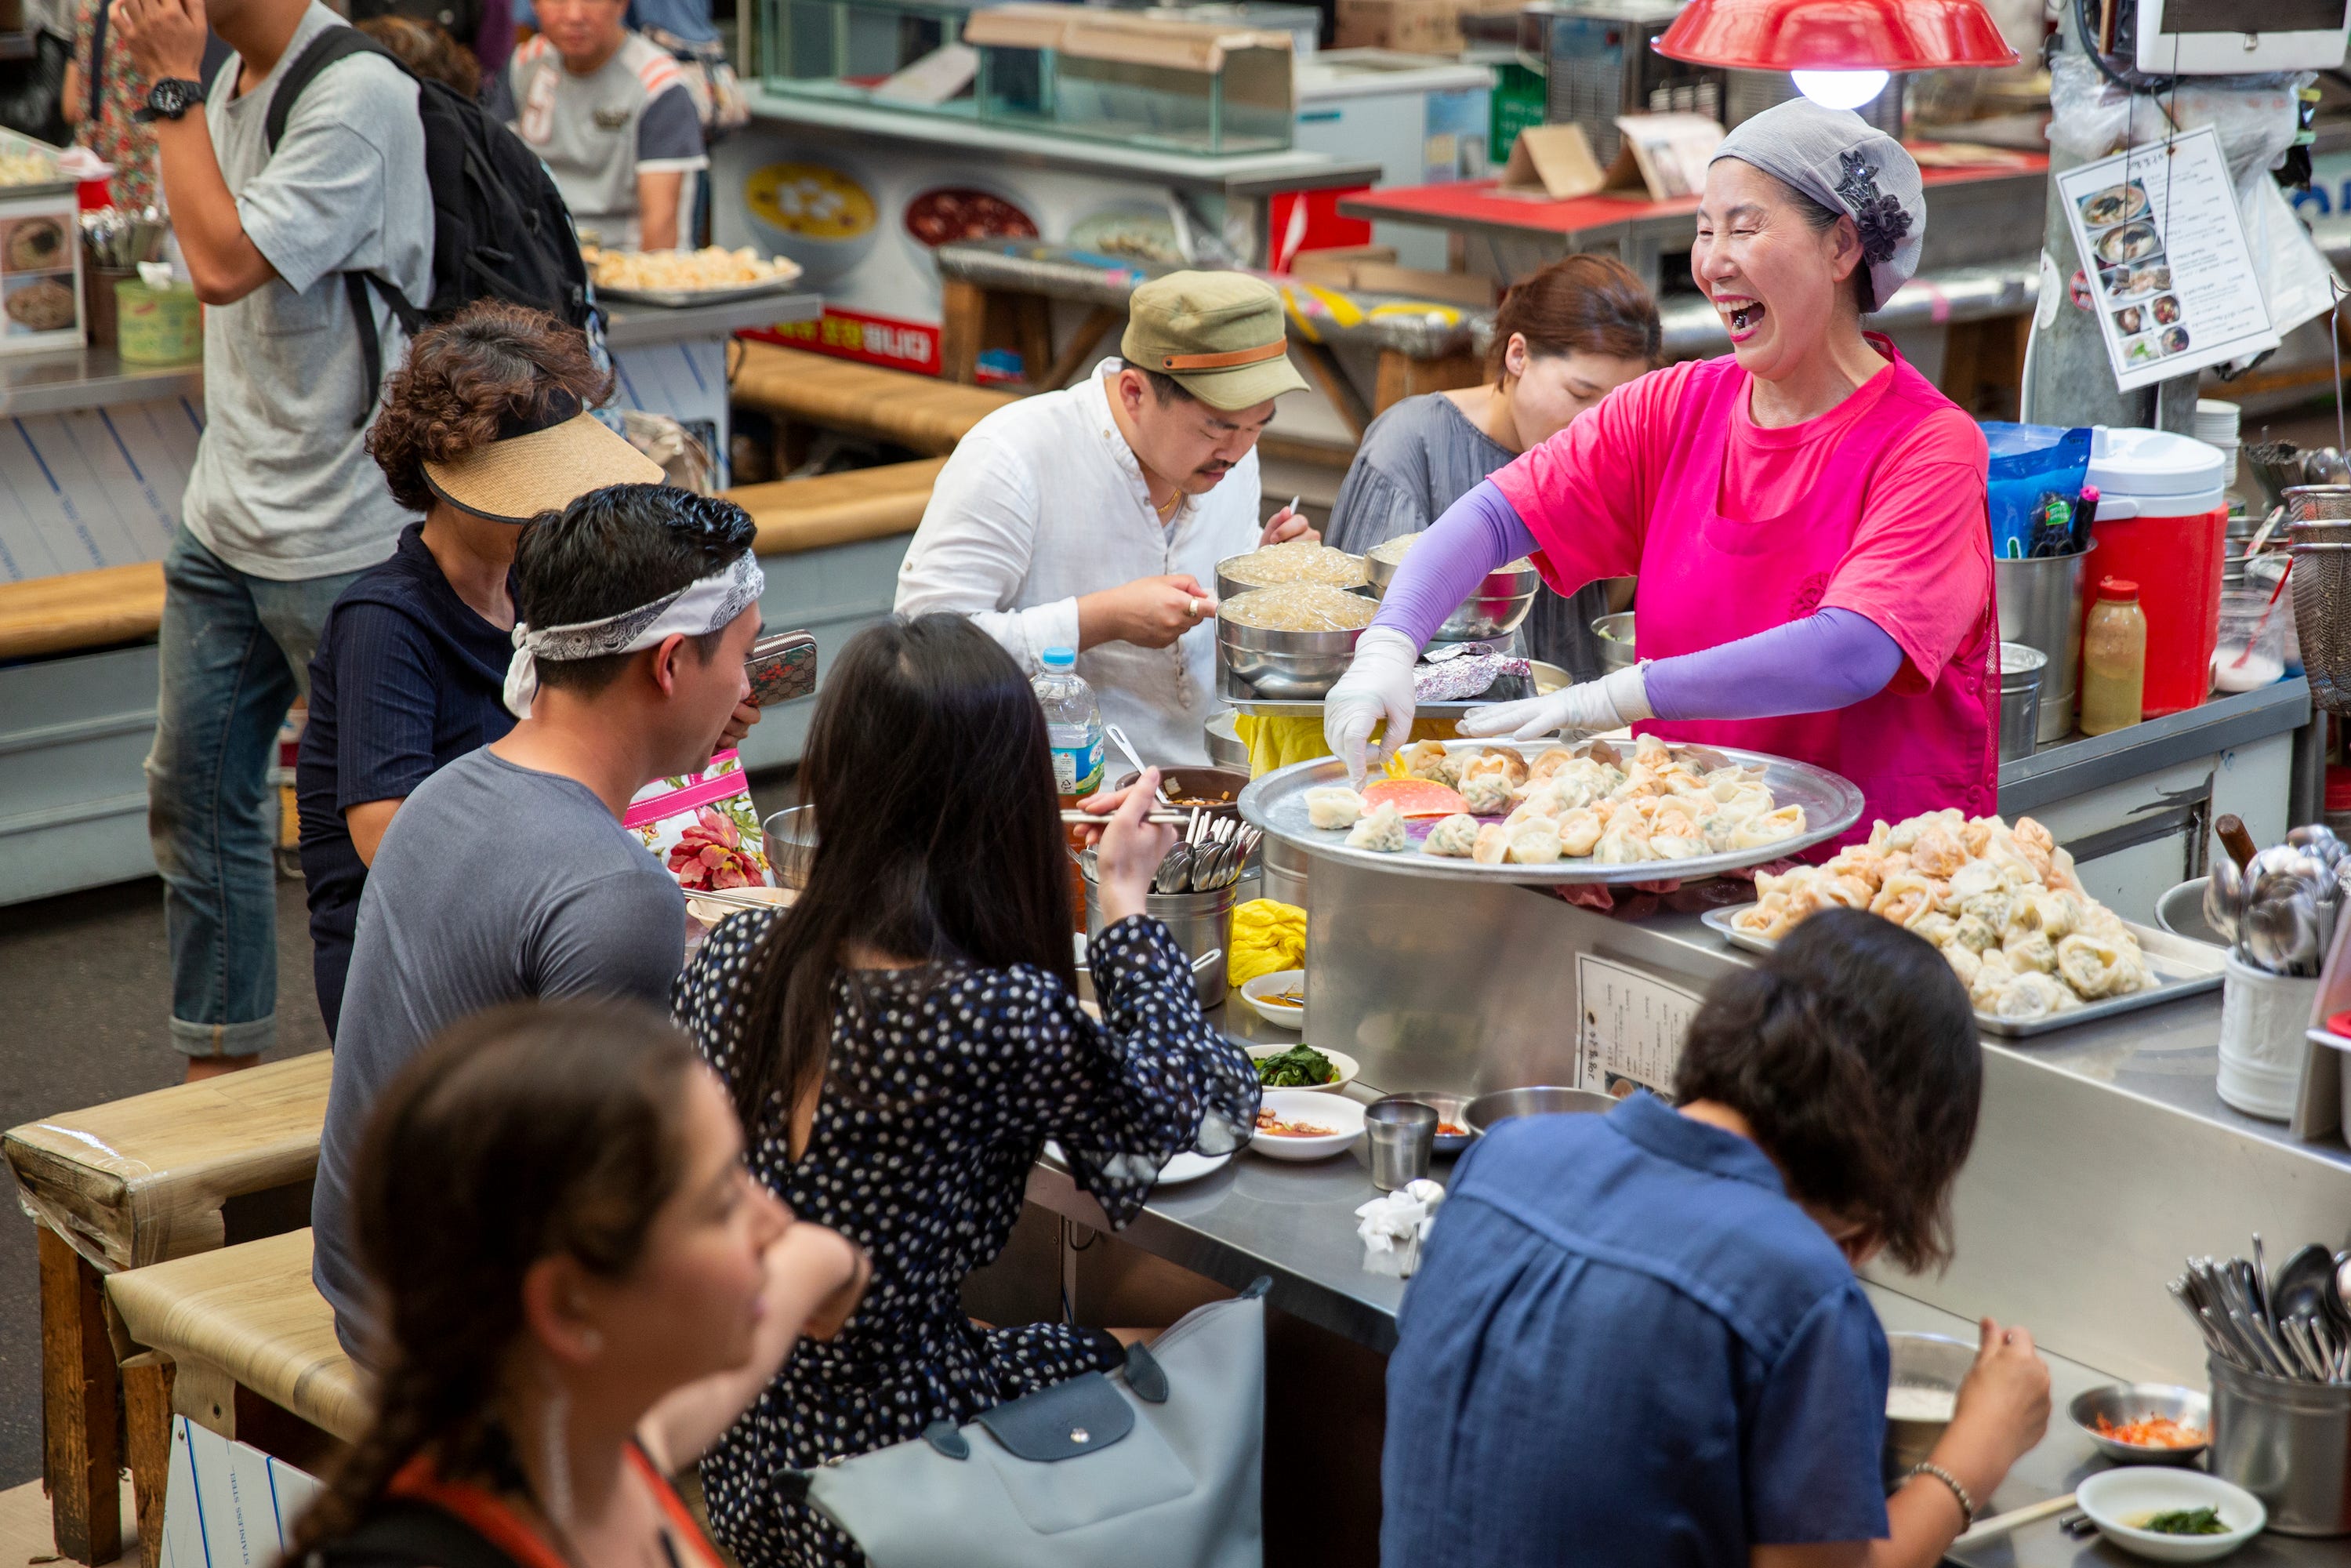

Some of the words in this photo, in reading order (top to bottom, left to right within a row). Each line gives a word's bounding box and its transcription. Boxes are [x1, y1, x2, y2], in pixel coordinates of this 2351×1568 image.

[521, 64, 560, 145] 5
[230, 1473, 240, 1504] STEEL
[236, 1506, 250, 1566] STAINLESS
